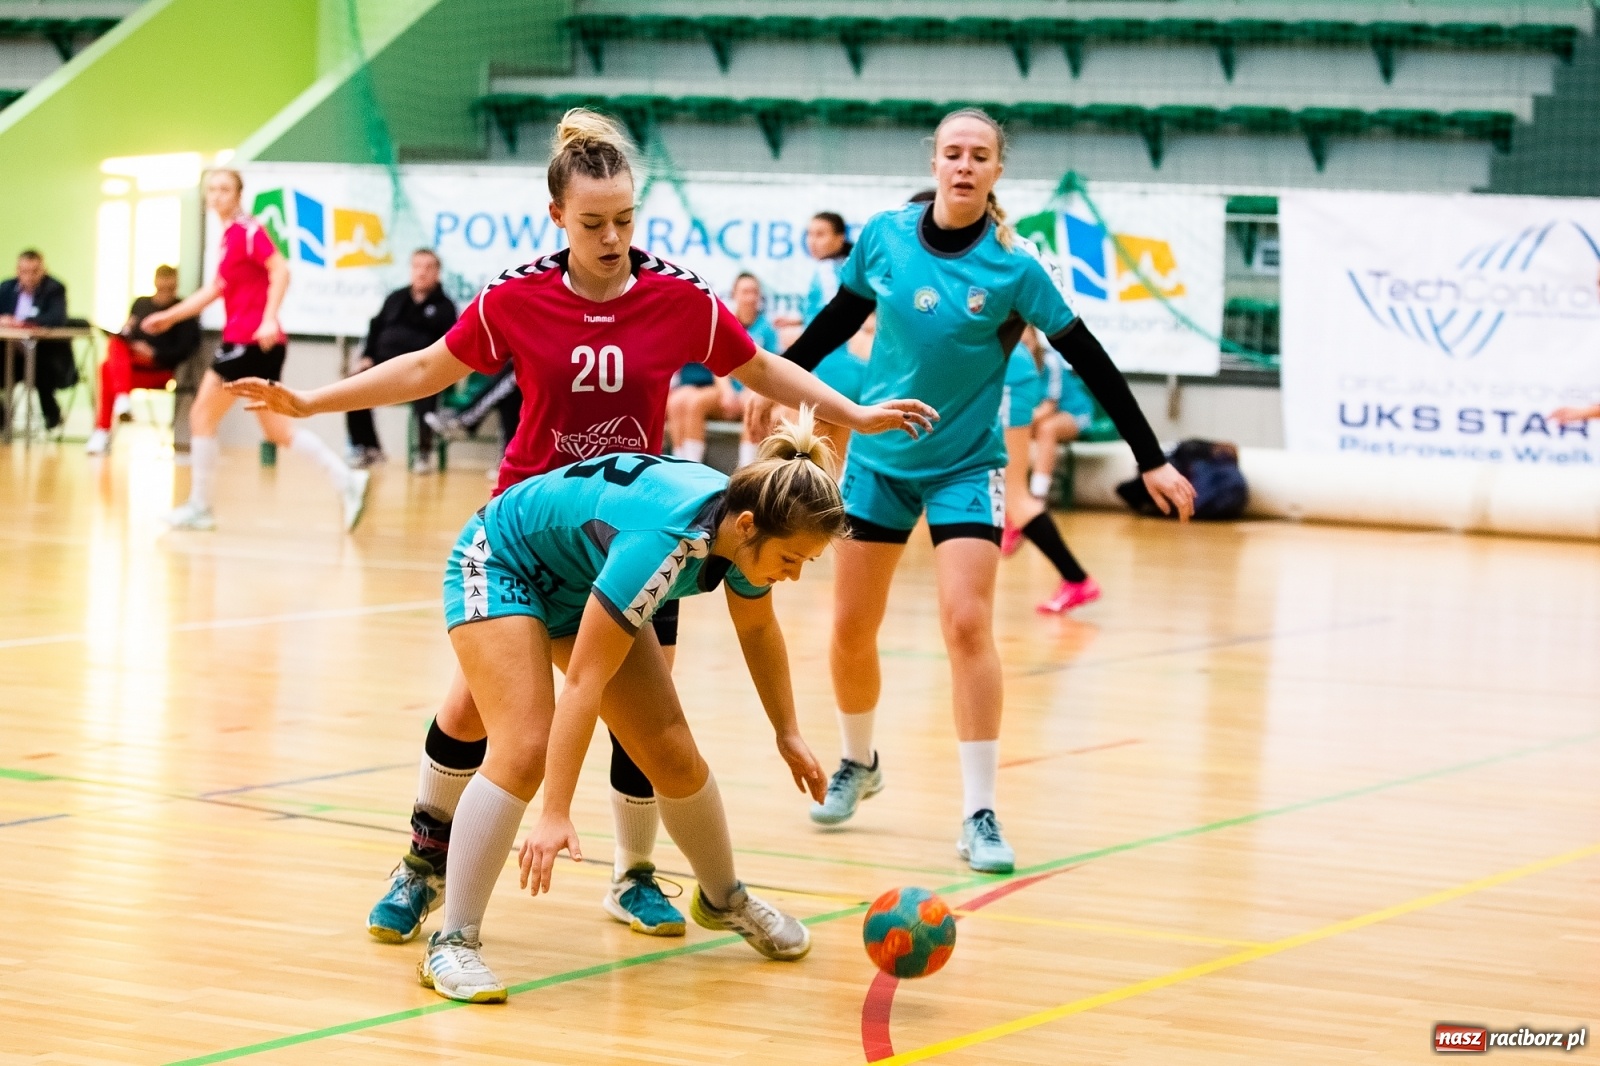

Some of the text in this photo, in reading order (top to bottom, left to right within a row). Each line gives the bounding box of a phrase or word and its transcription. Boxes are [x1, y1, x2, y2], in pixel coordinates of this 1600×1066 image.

[1366, 268, 1598, 309] TechContro
[583, 313, 616, 323] hummel
[571, 344, 624, 393] 20
[1338, 403, 1441, 432] UKS
[556, 429, 642, 447] TechControl
[499, 575, 531, 606] 33
